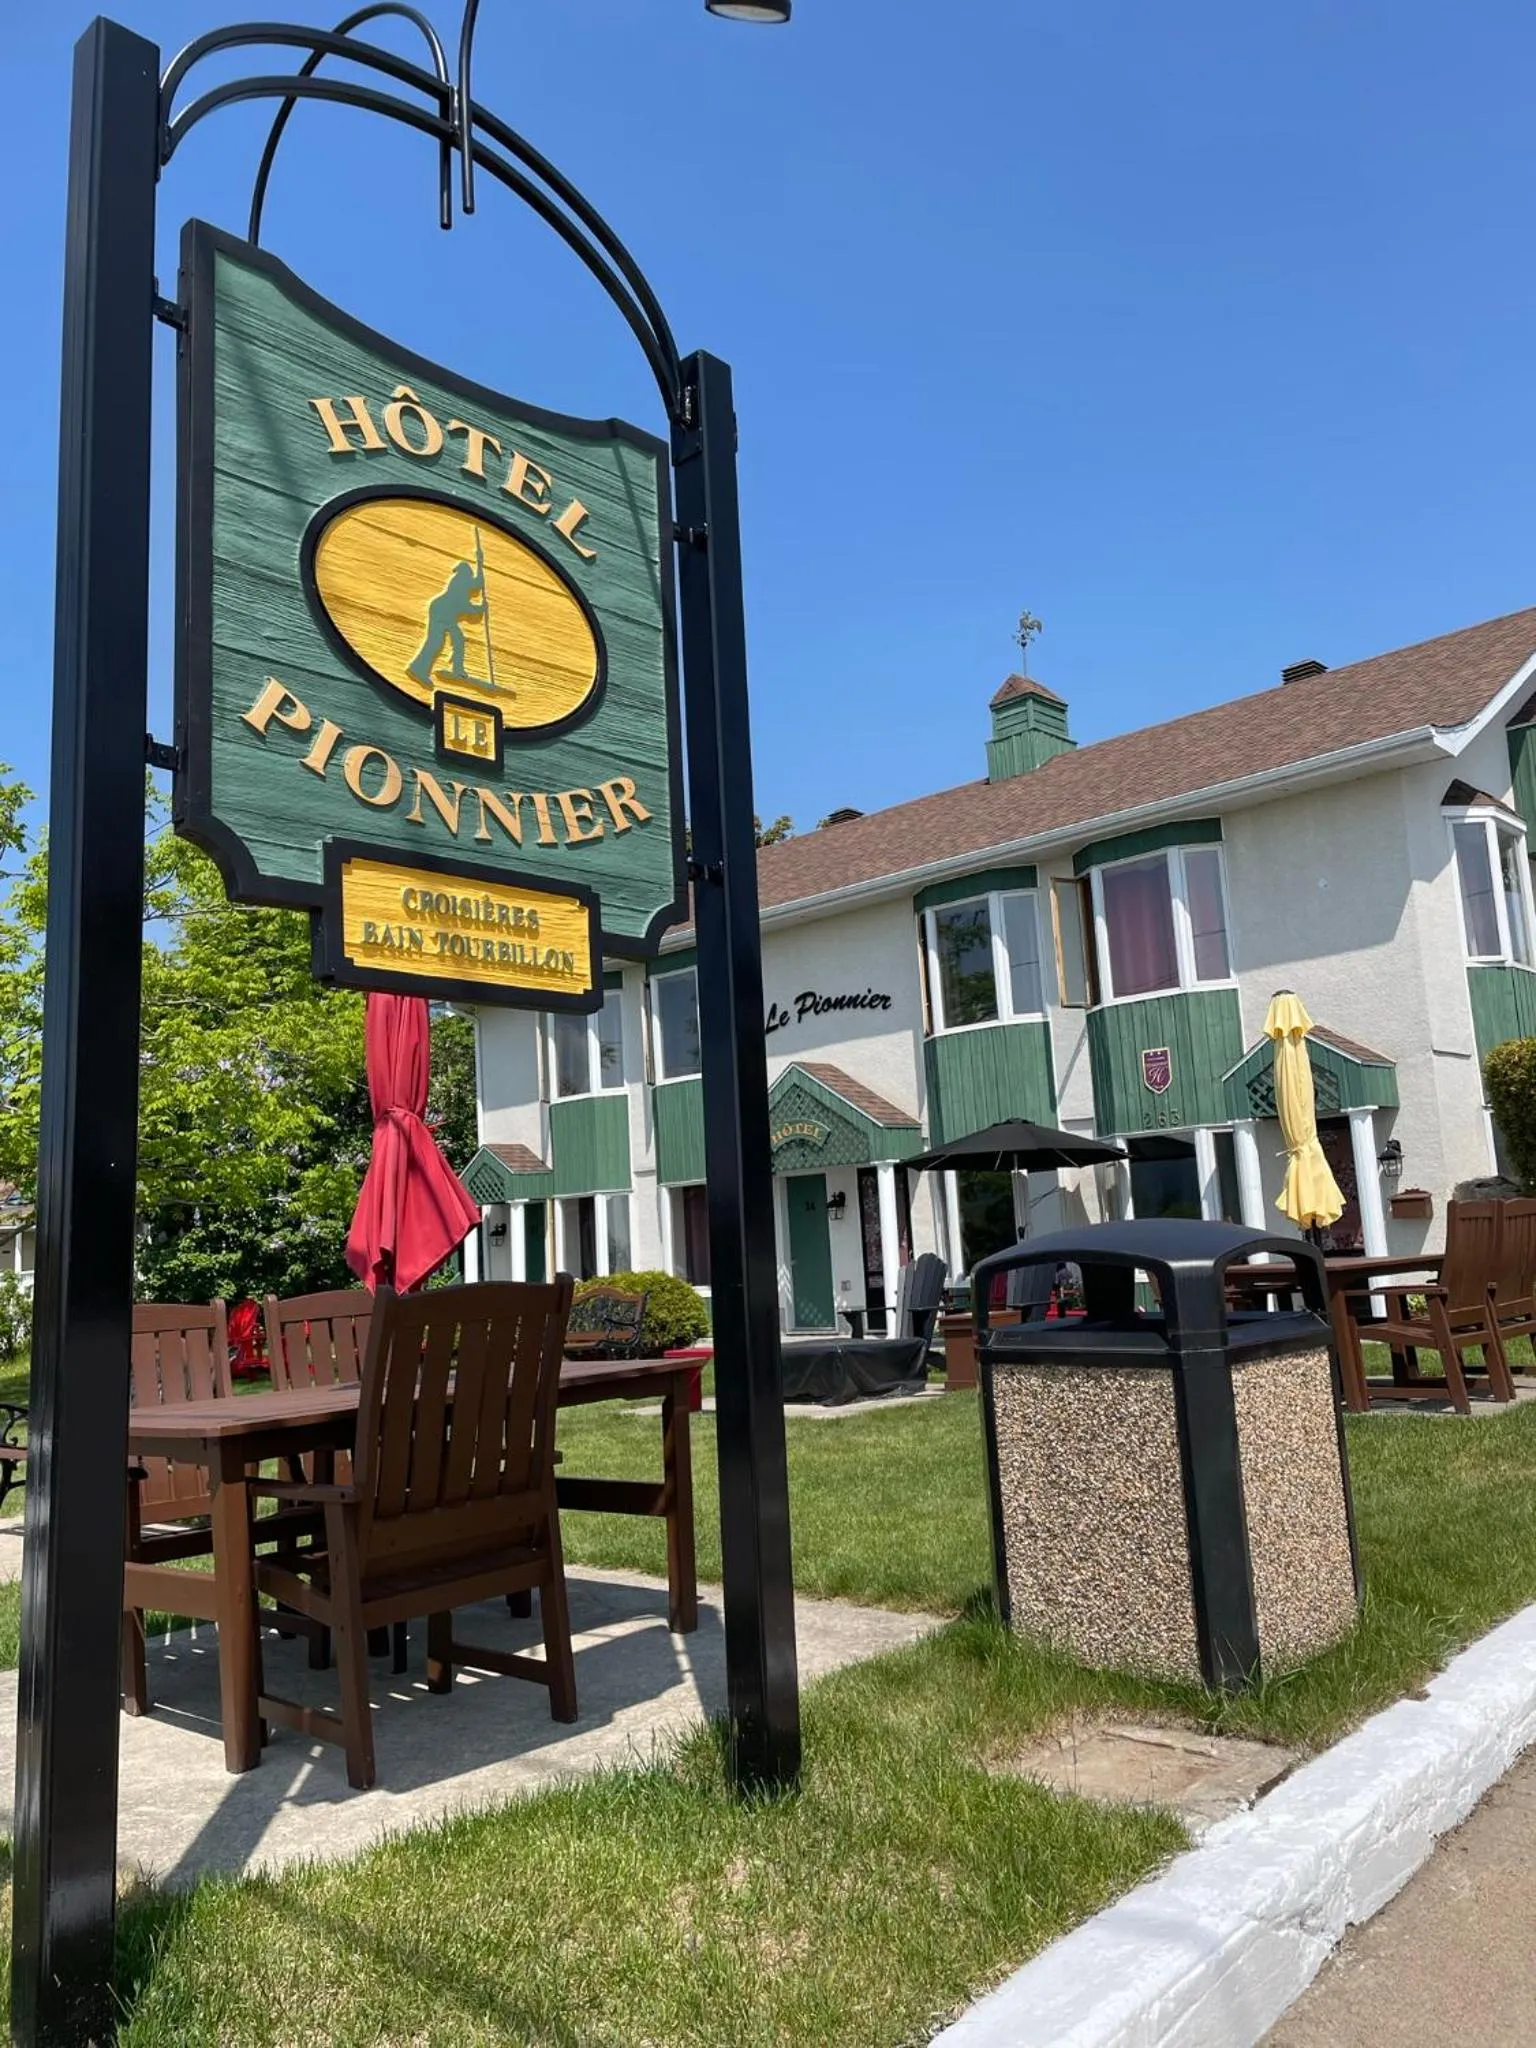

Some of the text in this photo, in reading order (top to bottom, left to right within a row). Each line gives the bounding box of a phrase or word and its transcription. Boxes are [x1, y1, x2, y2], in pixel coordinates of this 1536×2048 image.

[308, 385, 597, 560] HÔTEL
[451, 713, 488, 747] LE
[241, 676, 652, 845] PIONNIER
[362, 921, 575, 973] BAIN TOURBILLON
[766, 988, 892, 1034] Le Pionnier
